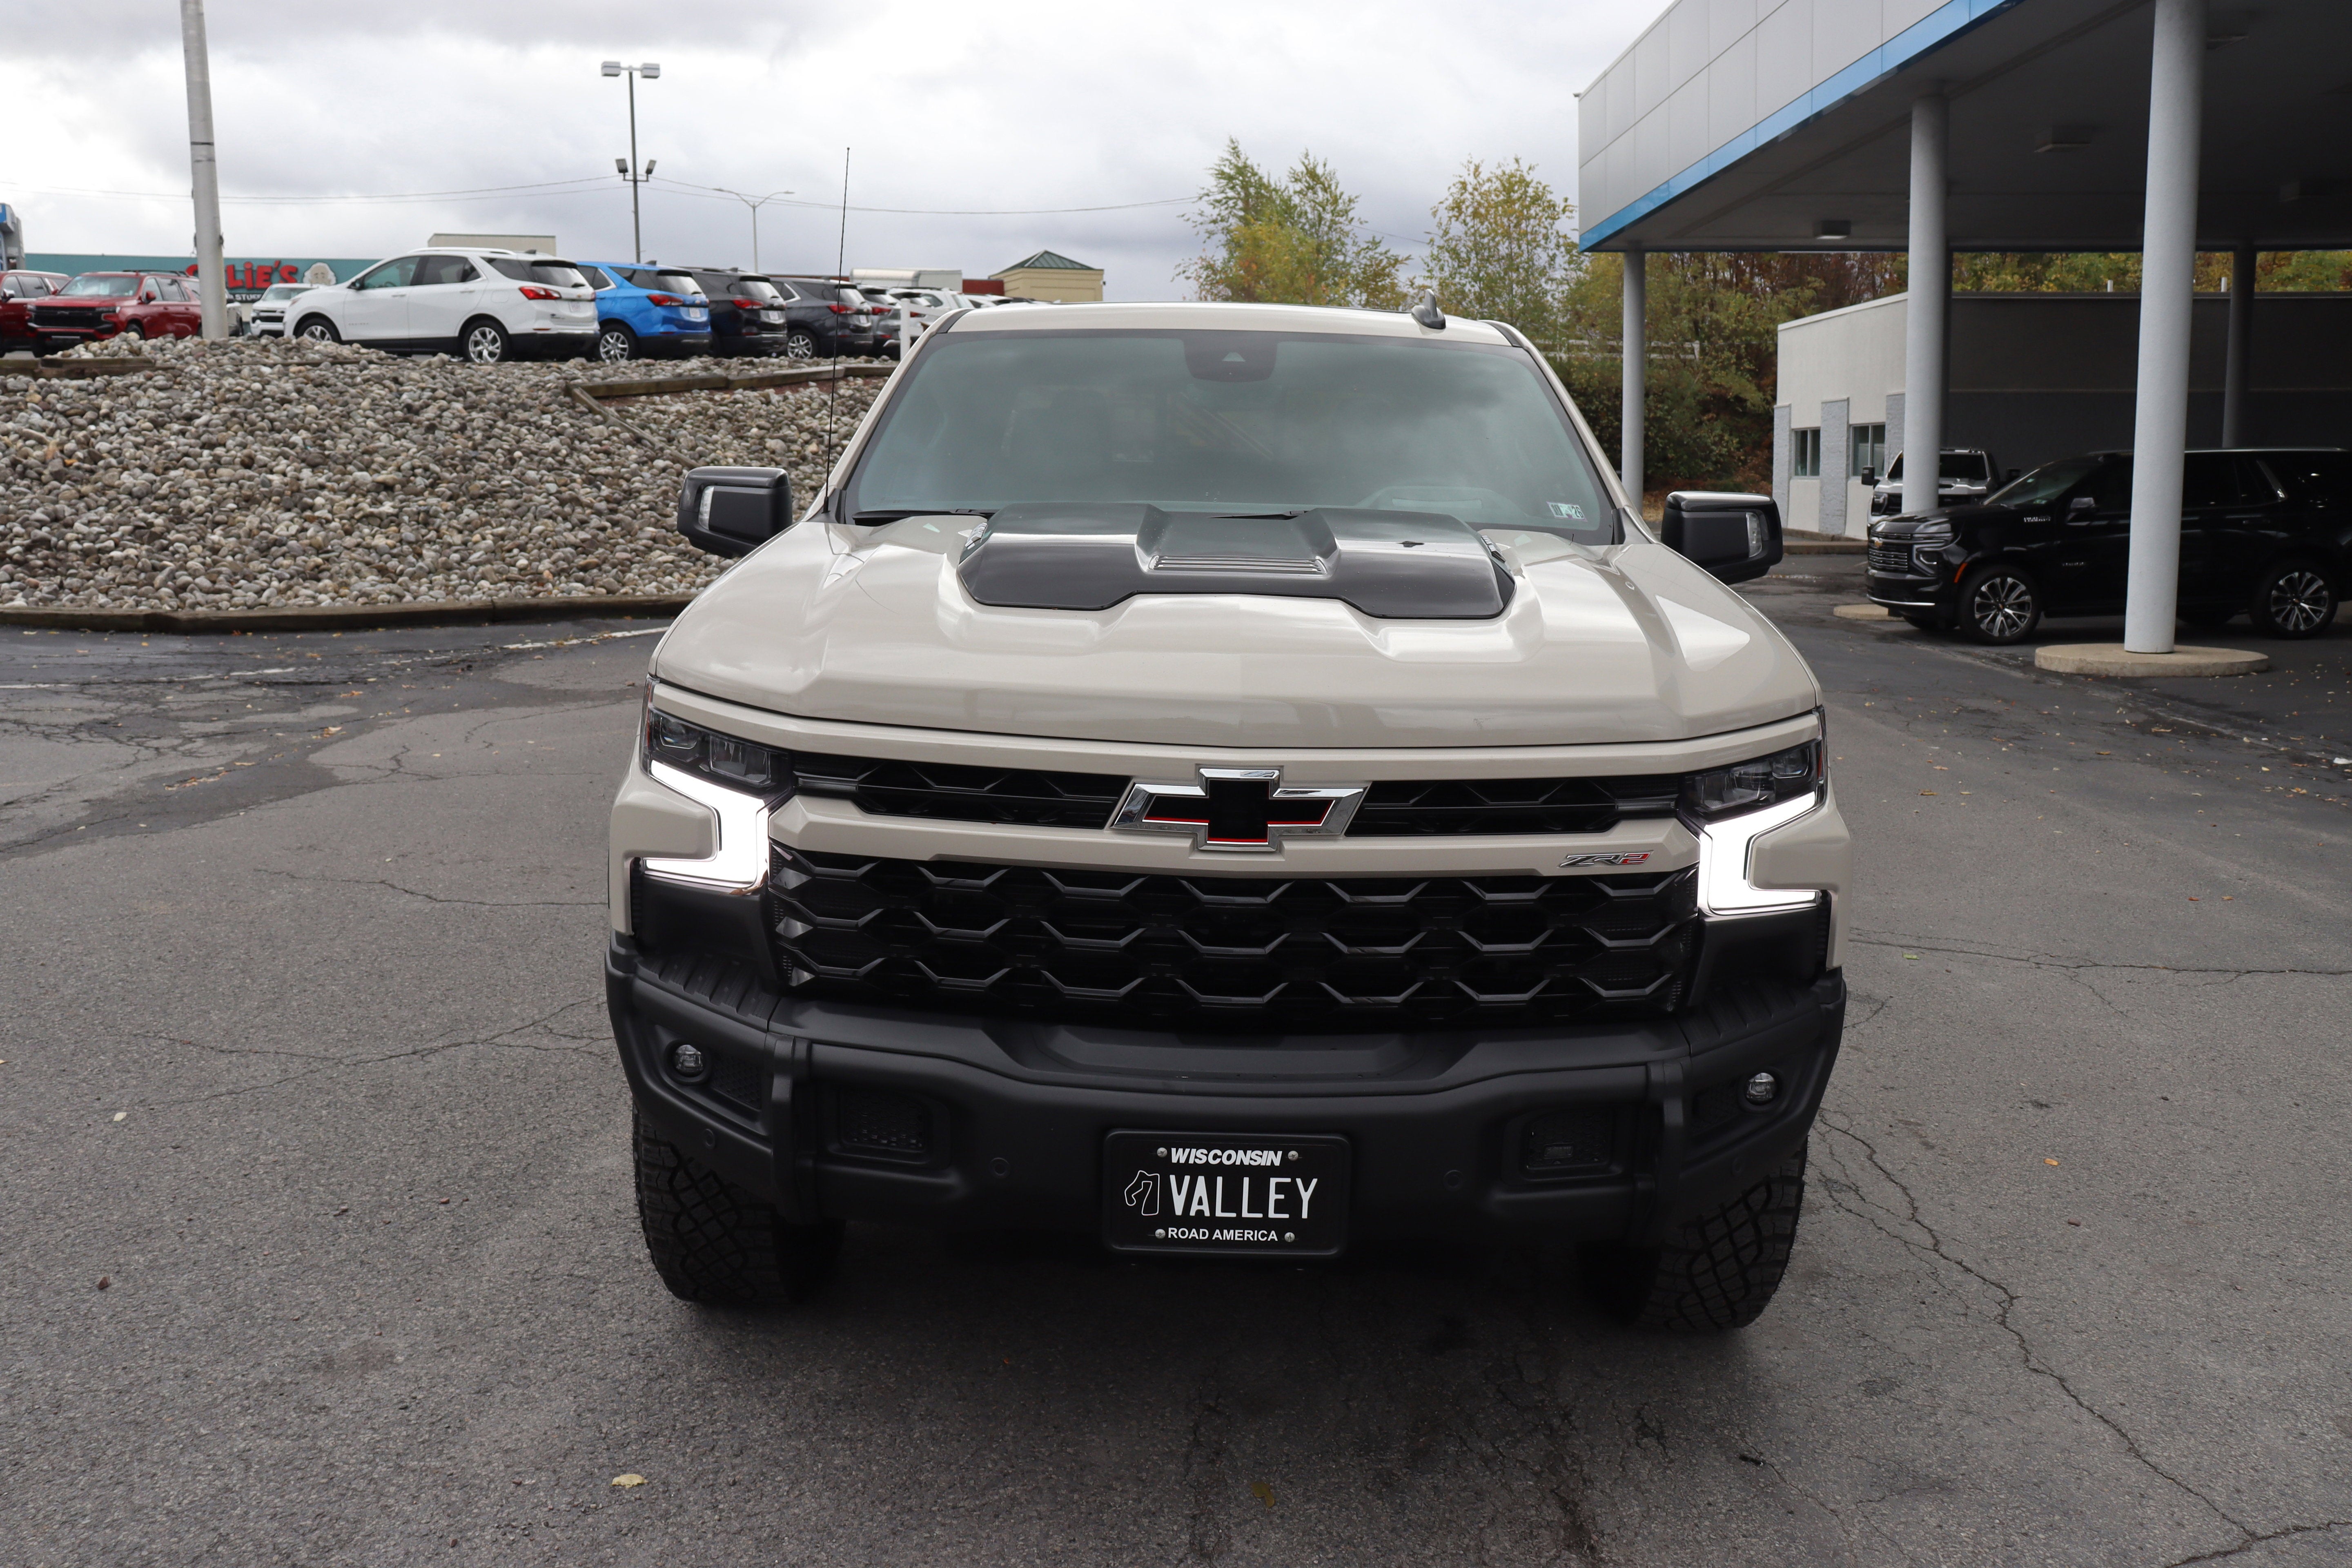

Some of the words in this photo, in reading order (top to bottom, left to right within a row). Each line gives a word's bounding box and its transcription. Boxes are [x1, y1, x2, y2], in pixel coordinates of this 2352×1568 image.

[1572, 506, 1584, 518] 26
[1558, 850, 1652, 867] ZR2
[1171, 1148, 1282, 1166] WISCONSIN
[1169, 1174, 1318, 1219] VALLEY
[1168, 1227, 1209, 1240] ROAD
[1212, 1229, 1278, 1241] AMERICA
